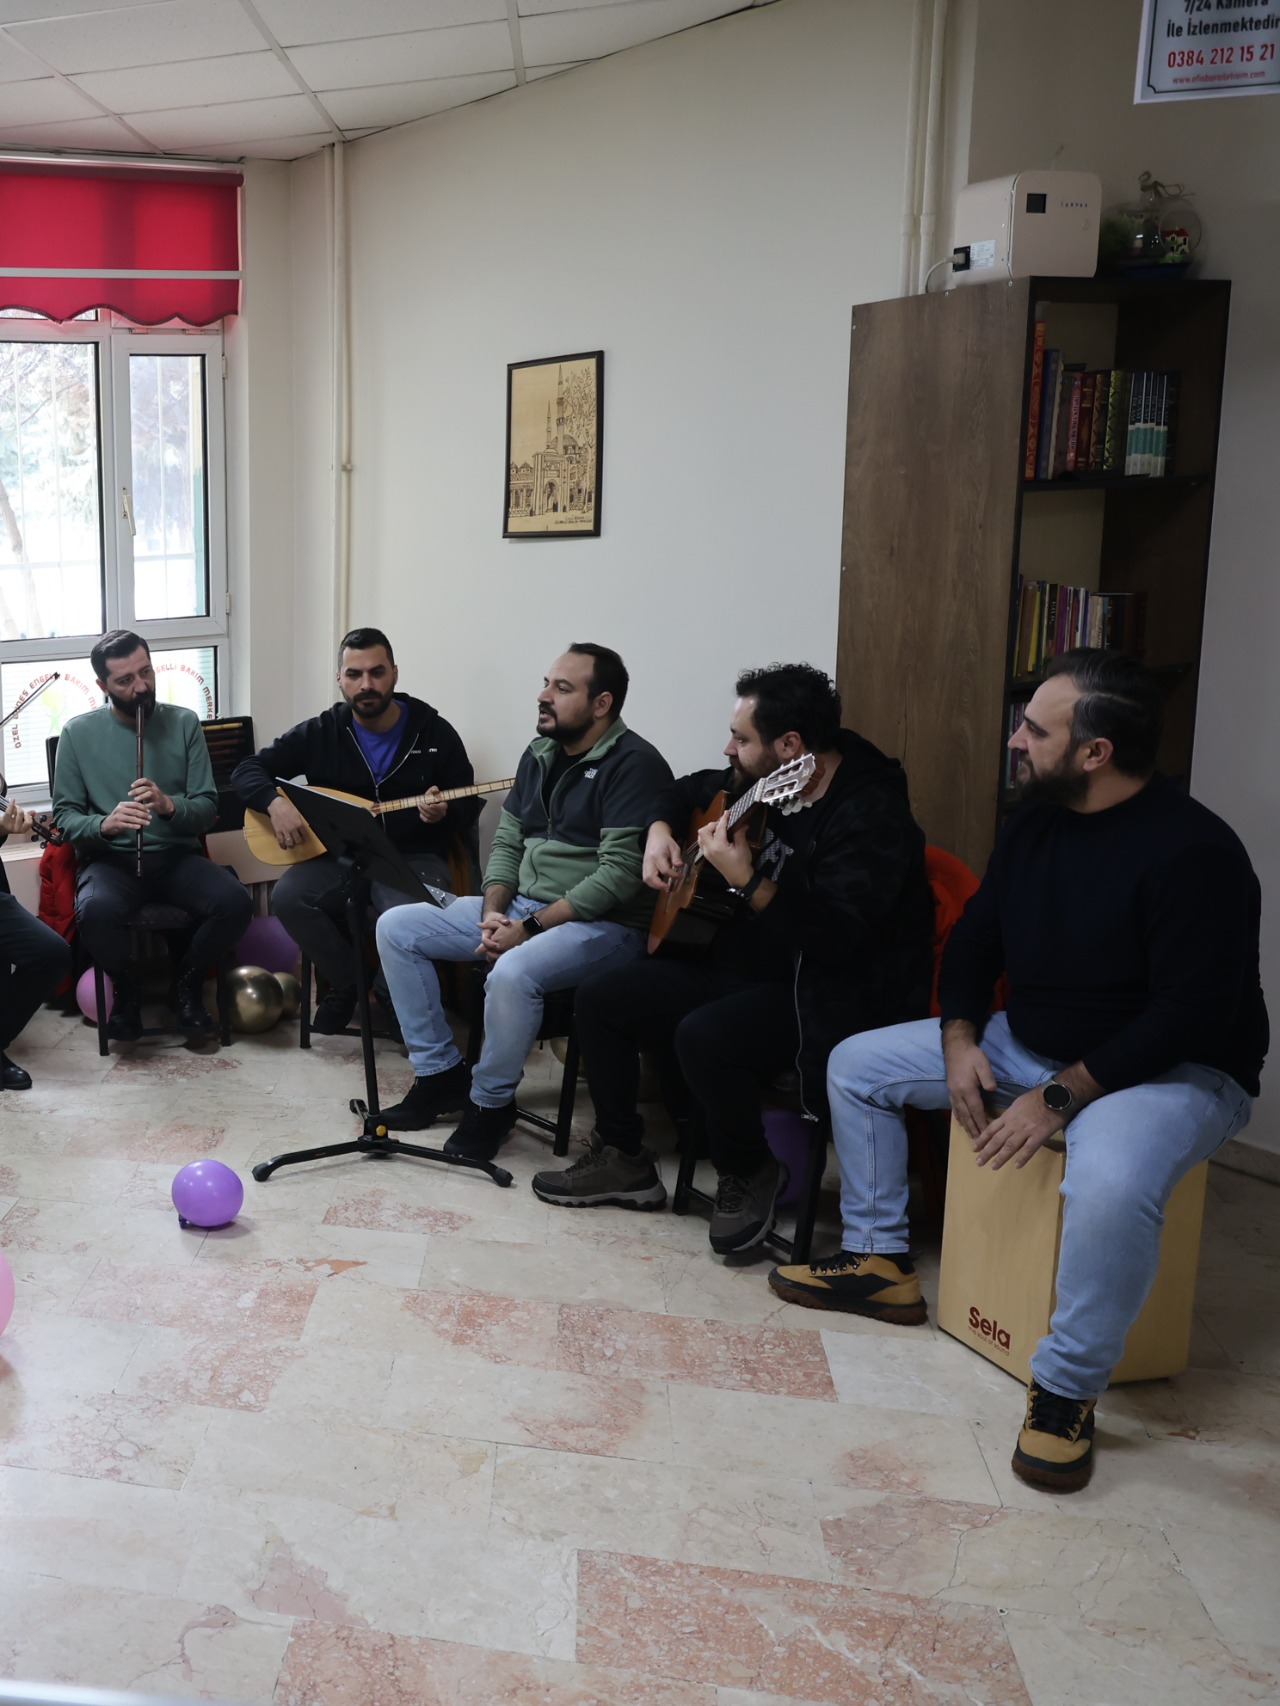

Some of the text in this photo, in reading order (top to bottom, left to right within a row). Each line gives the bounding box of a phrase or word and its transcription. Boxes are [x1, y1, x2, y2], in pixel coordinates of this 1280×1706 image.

[1167, 19, 1183, 38] İle
[1167, 43, 1275, 68] 0384 212 15 21
[155, 664, 177, 674] GELLI
[202, 686, 214, 720] MERKE
[968, 1306, 1011, 1350] Sela
